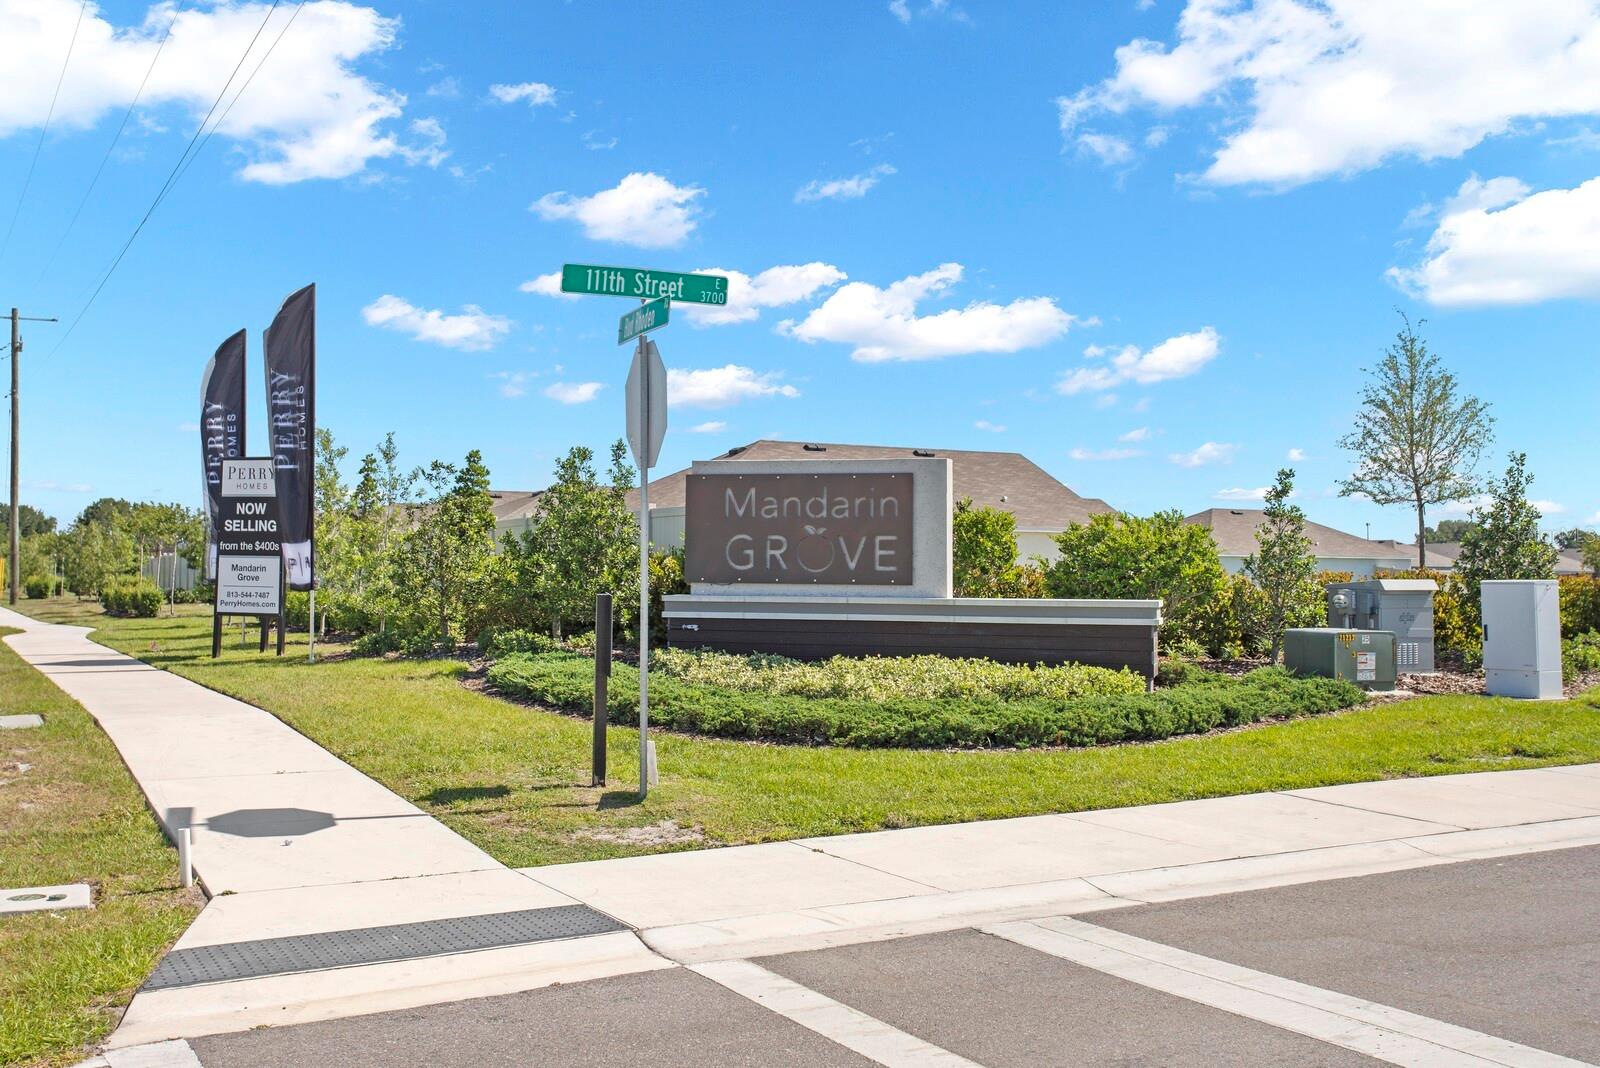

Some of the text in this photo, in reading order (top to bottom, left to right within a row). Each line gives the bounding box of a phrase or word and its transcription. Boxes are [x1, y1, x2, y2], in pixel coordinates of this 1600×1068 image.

[587, 269, 684, 299] 111th Street
[715, 279, 721, 290] E
[700, 291, 724, 304] 3700
[271, 367, 299, 472] PERRY
[296, 385, 307, 450] HOMES
[205, 400, 225, 484] PERRY
[227, 414, 238, 457] OMES
[228, 466, 275, 480] PERRY
[236, 502, 267, 515] NOW
[724, 486, 898, 519] Mandarin
[224, 519, 277, 532] SELLING
[220, 541, 280, 551] from the $400s
[725, 533, 898, 573] GROVE
[231, 564, 267, 572] Mandarin
[237, 573, 260, 581] Grove
[220, 600, 276, 608] PerryHomes.com
